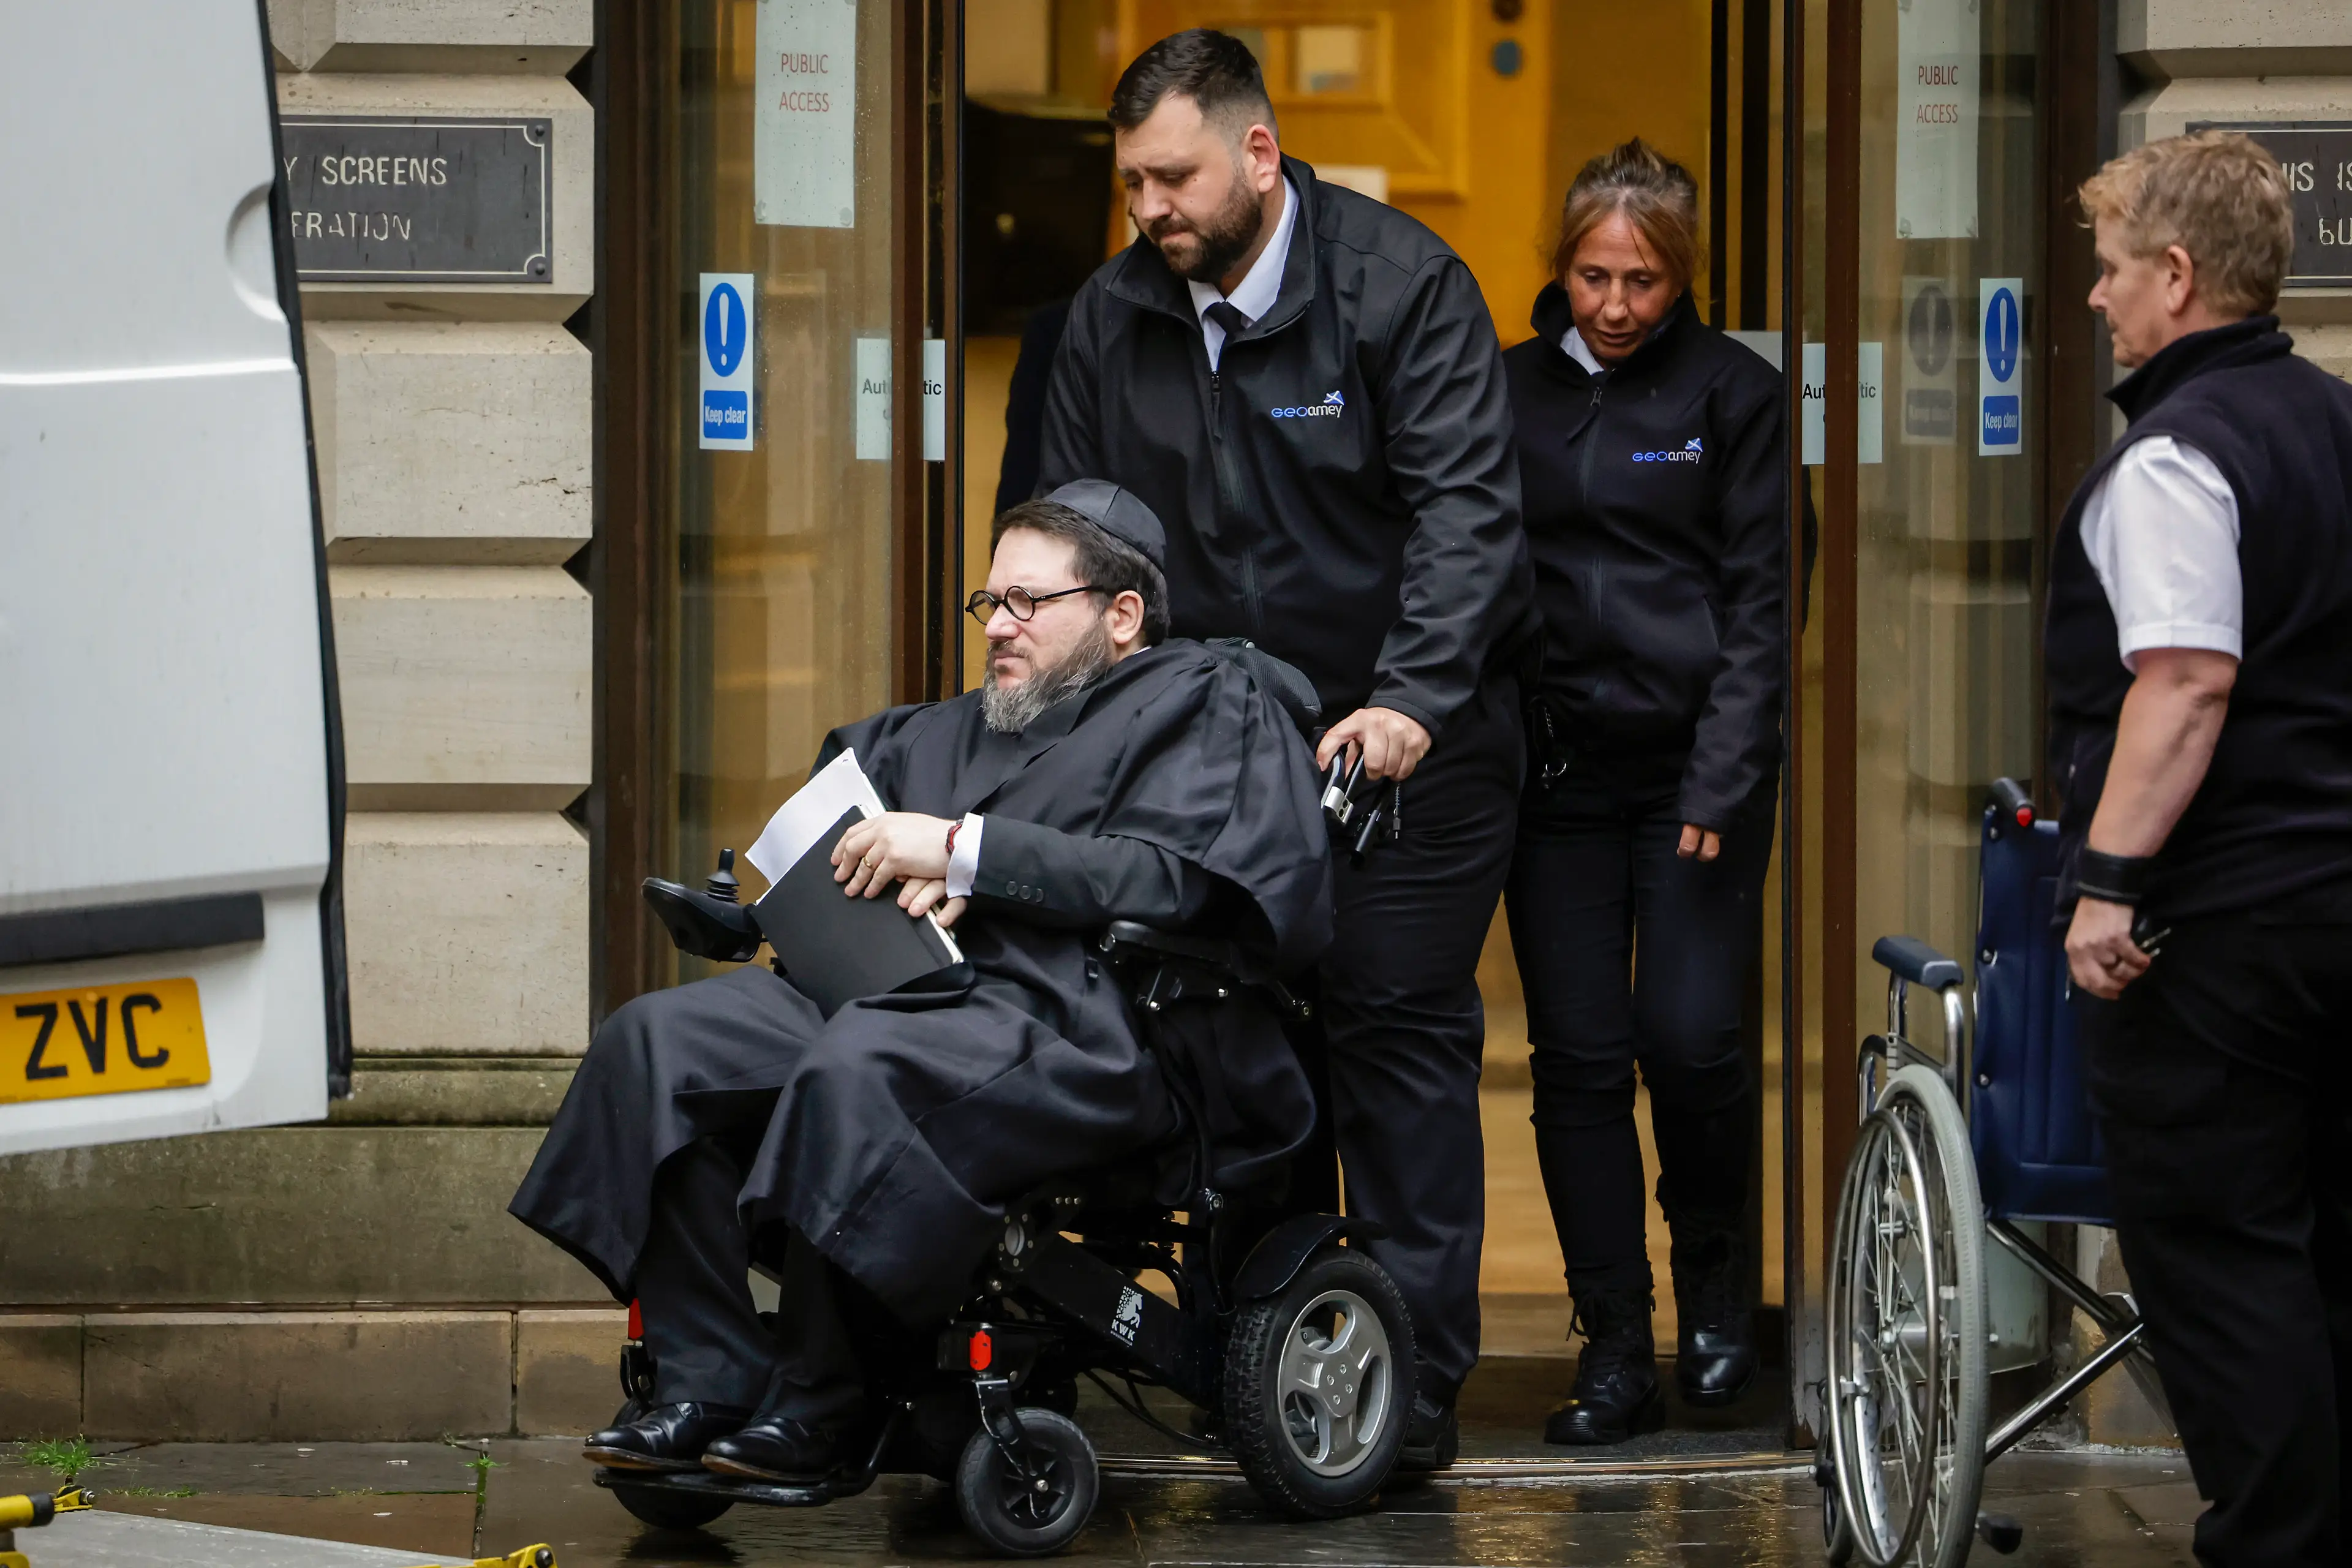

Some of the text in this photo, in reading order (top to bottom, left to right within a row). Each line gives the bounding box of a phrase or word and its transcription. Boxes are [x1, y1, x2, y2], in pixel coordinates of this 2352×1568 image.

[781, 53, 829, 74] PUBLIC
[1918, 66, 1959, 85] PUBLIC
[779, 91, 829, 112] ACCESS
[1916, 104, 1958, 123] ACCESS
[283, 156, 447, 185] Y SCREENS
[291, 211, 411, 241] ERATION
[862, 378, 941, 395] Auttic
[1802, 381, 1876, 399] Auttic
[705, 405, 746, 427] Keep clear
[1985, 412, 2018, 432] Keep clear
[13, 992, 170, 1082] ZVC
[1111, 1318, 1136, 1341] KWK
